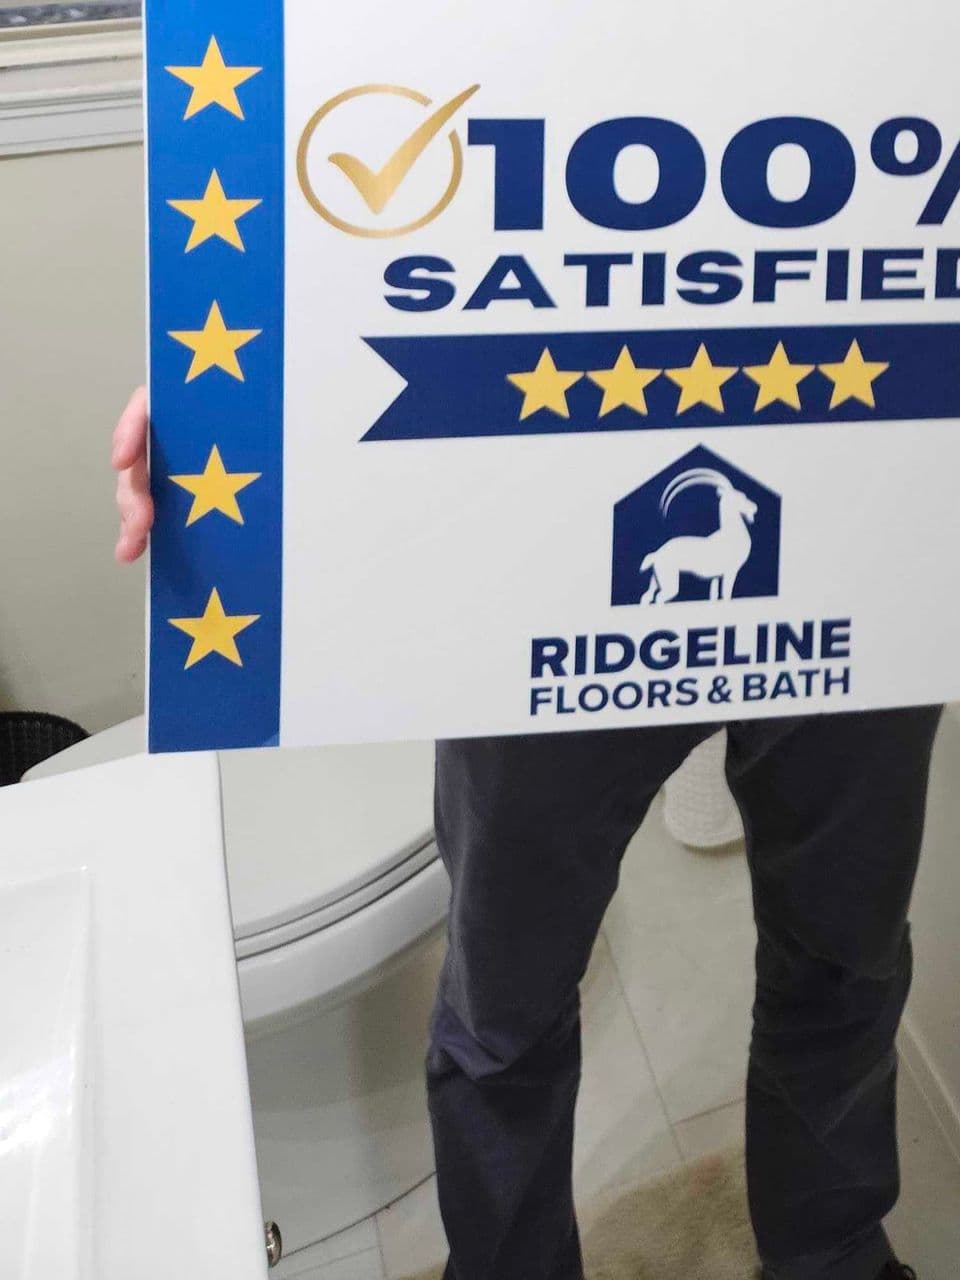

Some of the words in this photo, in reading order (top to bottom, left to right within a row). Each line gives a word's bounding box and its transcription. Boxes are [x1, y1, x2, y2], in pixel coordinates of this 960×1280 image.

[530, 617, 852, 680] RIDGELINE
[530, 676, 700, 717] FLOORS
[706, 675, 733, 705] &
[742, 666, 851, 703] BATH
